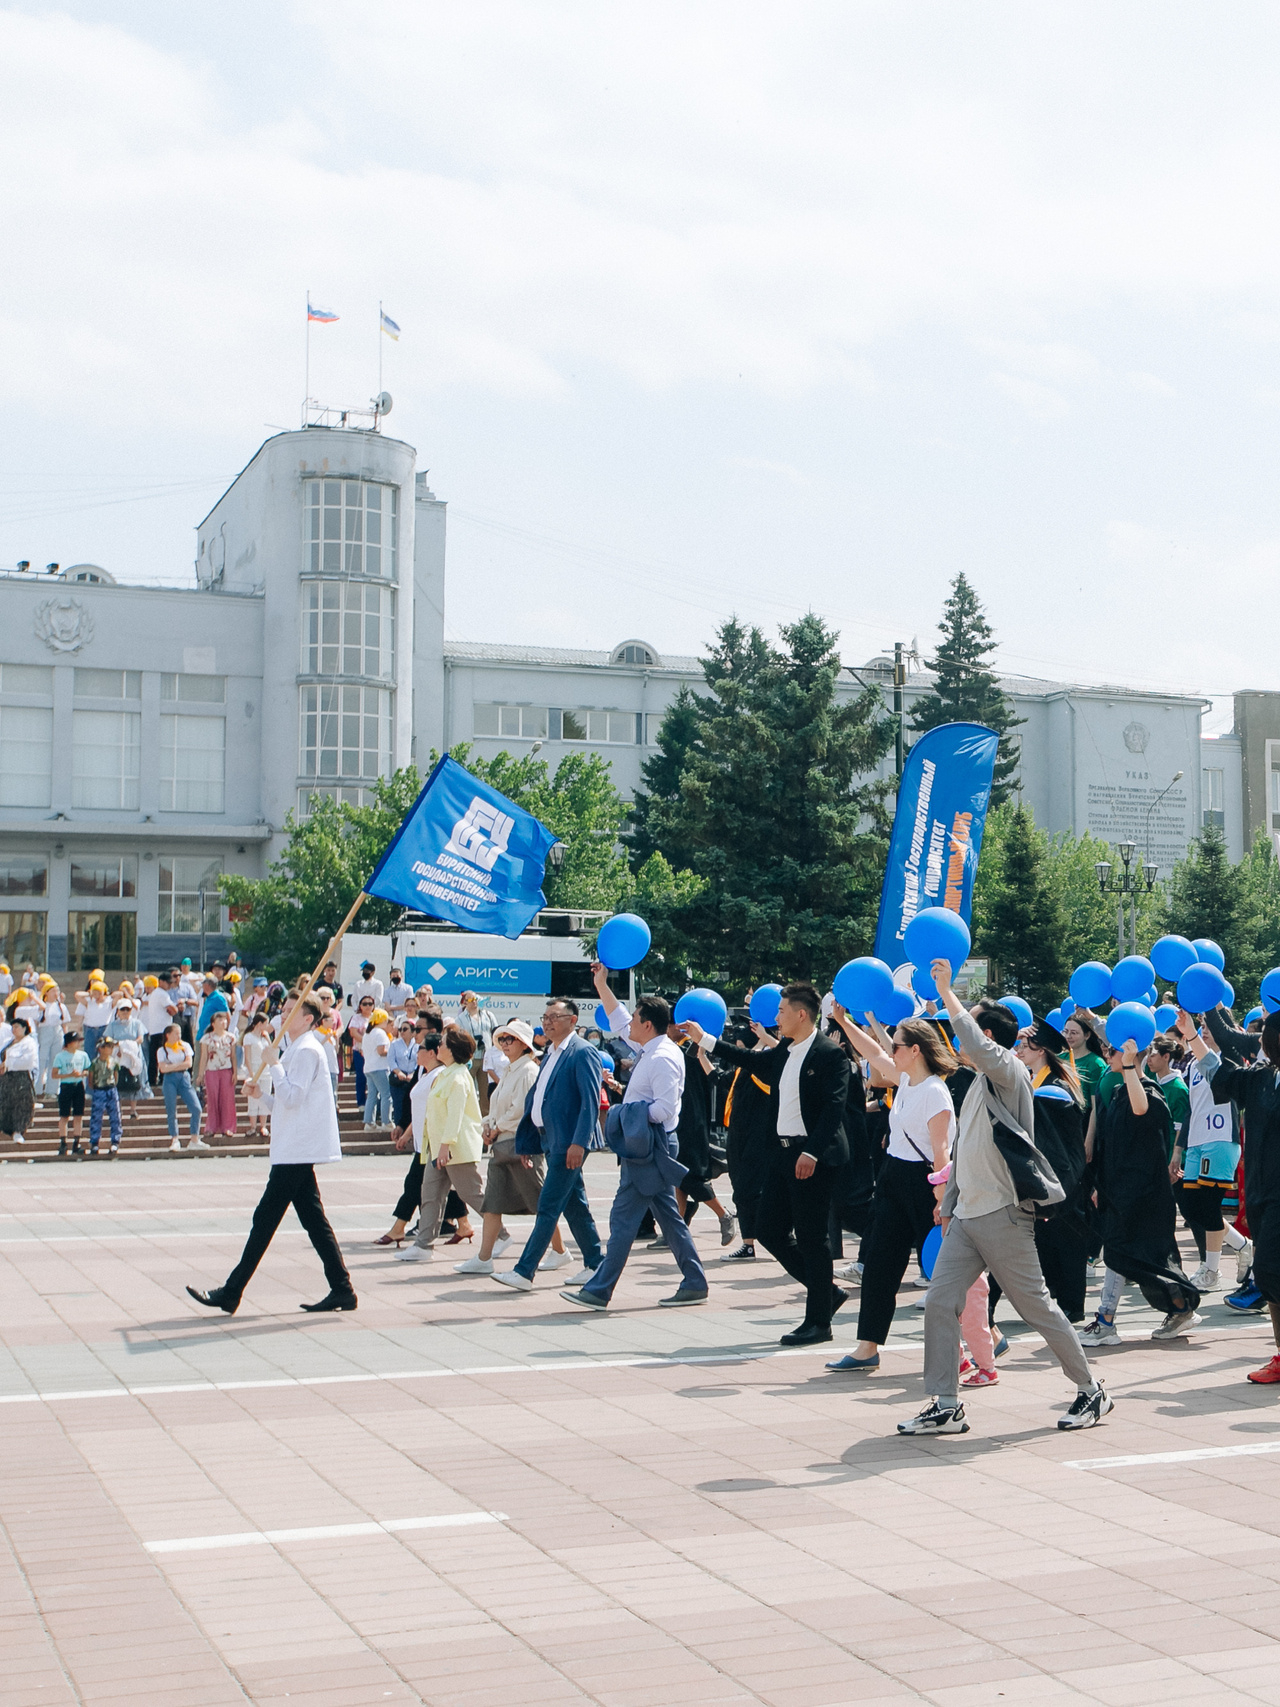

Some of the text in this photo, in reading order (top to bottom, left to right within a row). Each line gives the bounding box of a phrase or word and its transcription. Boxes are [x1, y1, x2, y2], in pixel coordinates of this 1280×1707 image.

[1125, 770, 1149, 780] УКАЗ
[904, 758, 937, 874] Государственный
[923, 818, 947, 898] Университет
[416, 879, 481, 912] УНИВЕРСИТЕТ
[454, 966, 519, 980] АРИГУС
[1206, 1113, 1225, 1131] 10
